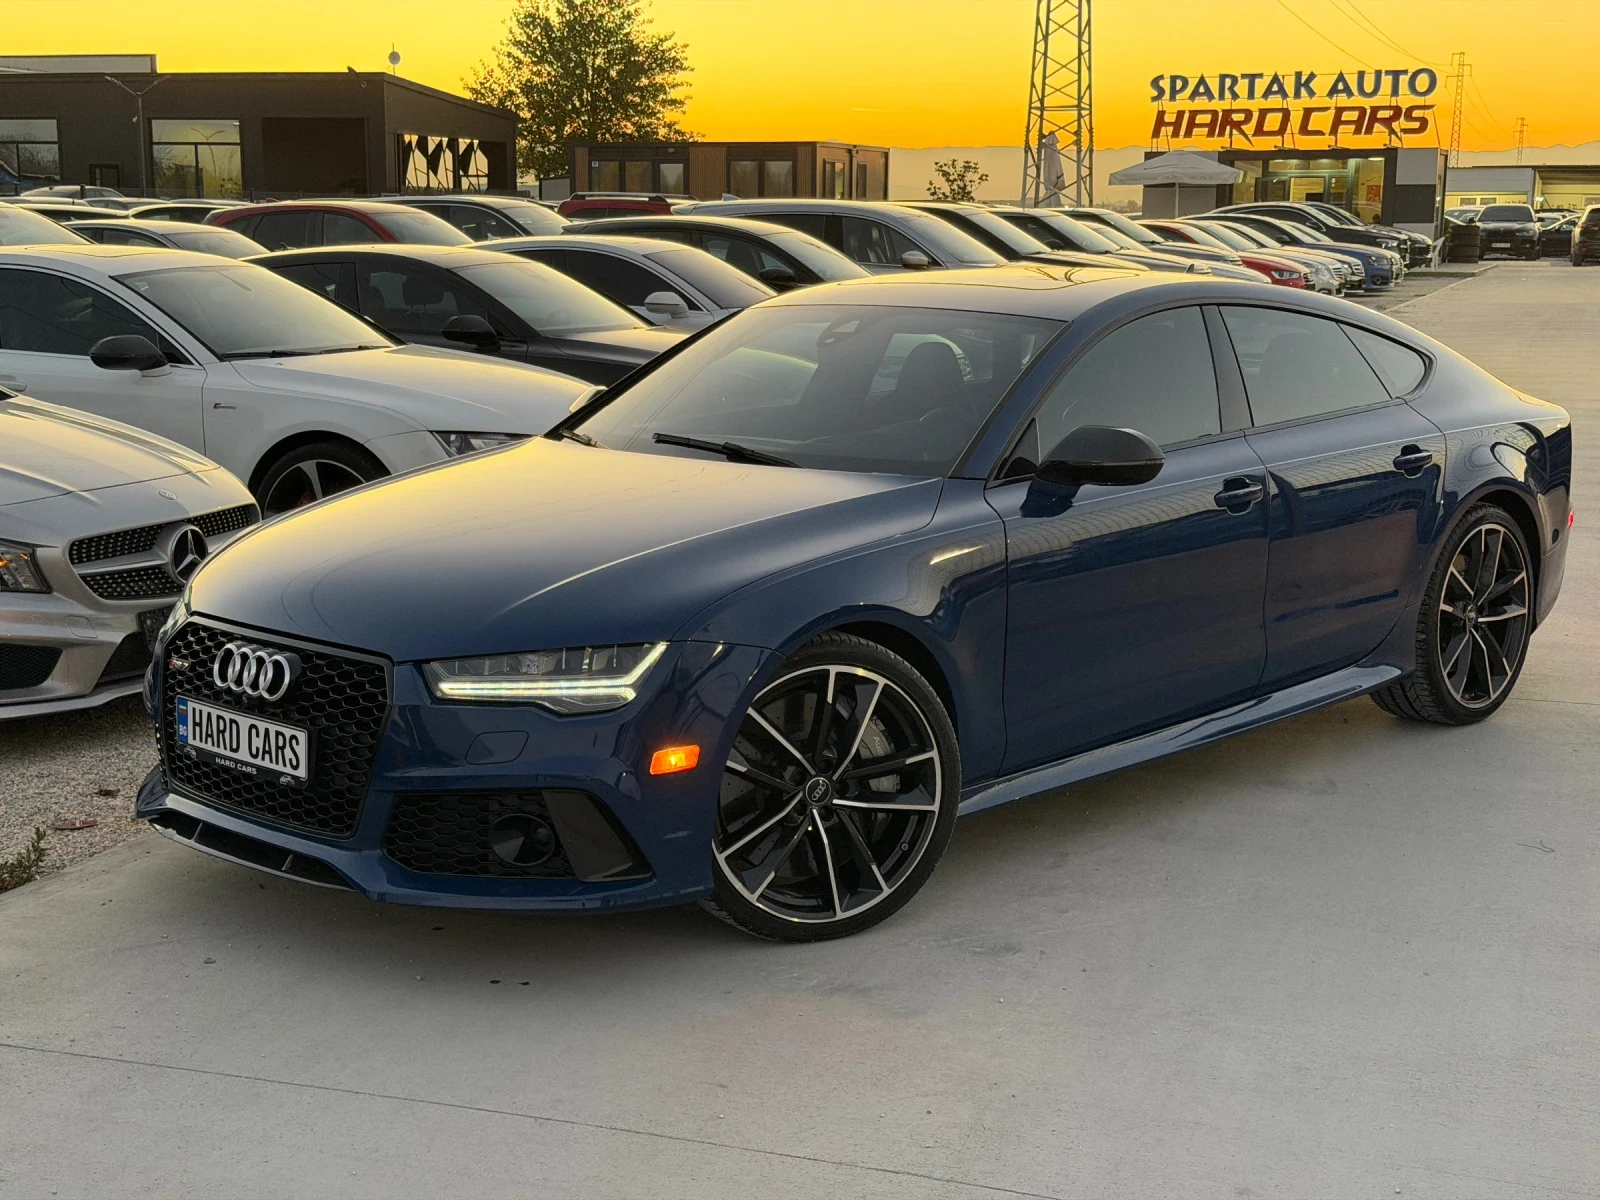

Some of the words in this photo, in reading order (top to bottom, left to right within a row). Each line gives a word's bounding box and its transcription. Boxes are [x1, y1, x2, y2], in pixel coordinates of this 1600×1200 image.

[1150, 71, 1317, 103] SPARTAK
[1326, 68, 1437, 100] AUTO
[1151, 107, 1291, 147] HARD
[1298, 104, 1436, 144] CARS
[179, 724, 188, 736] BG
[192, 707, 240, 754] HARD
[248, 723, 300, 771] CARS
[215, 757, 236, 769] HARD
[237, 763, 257, 775] CARS
